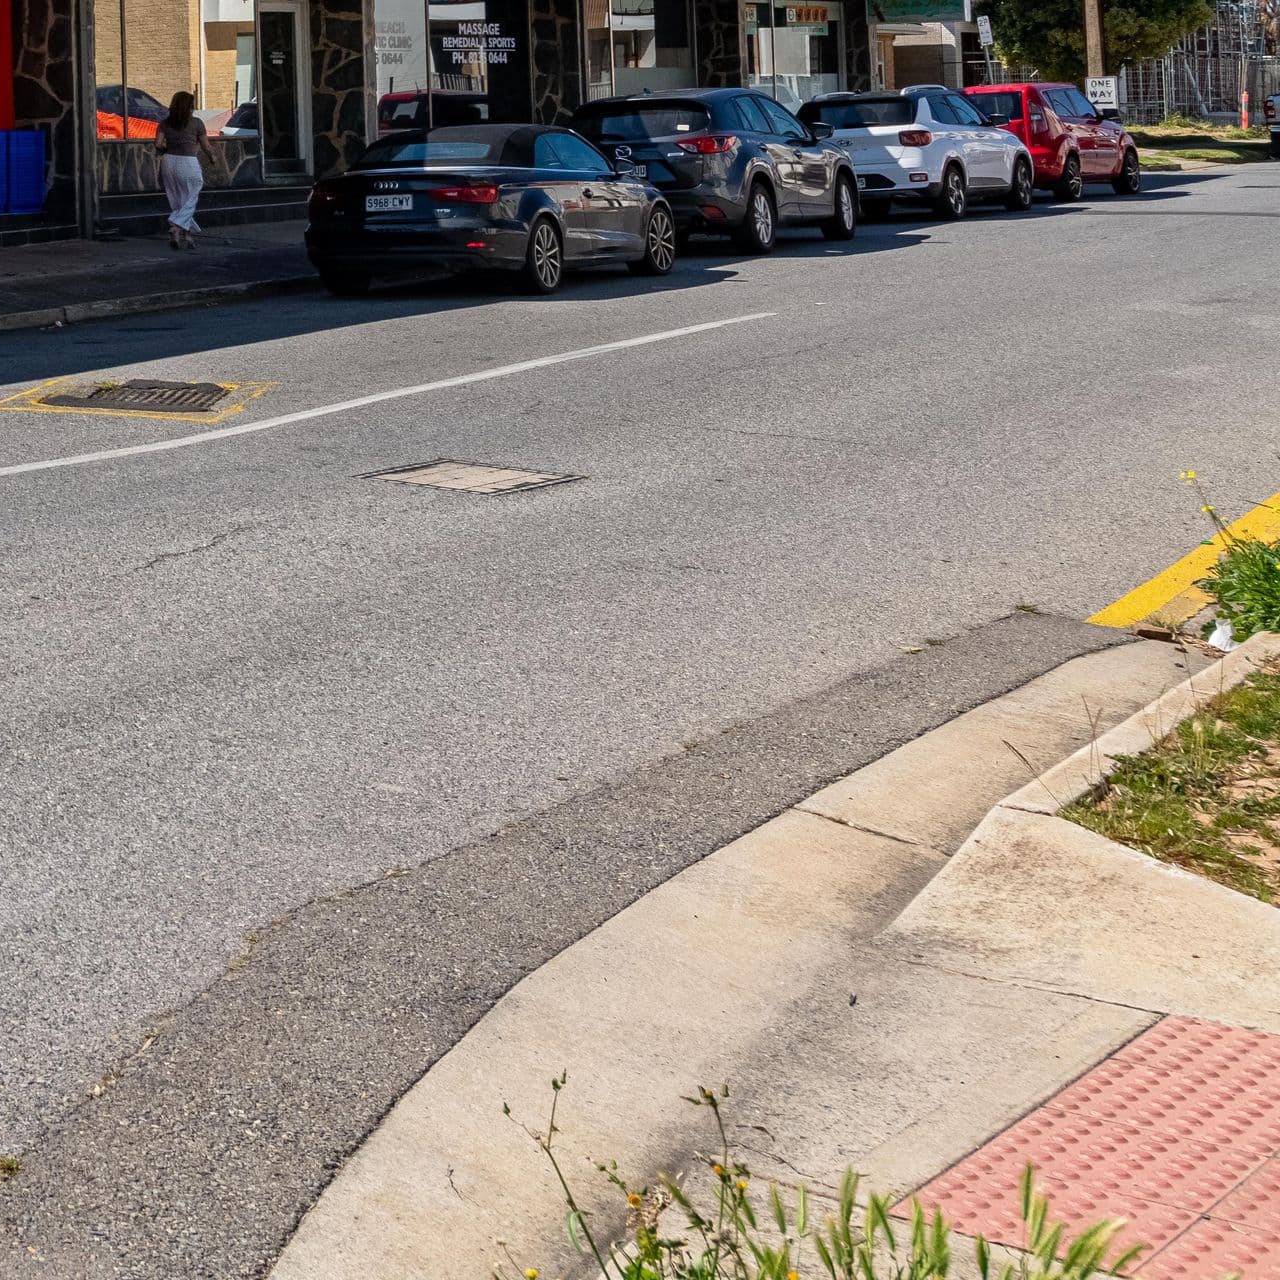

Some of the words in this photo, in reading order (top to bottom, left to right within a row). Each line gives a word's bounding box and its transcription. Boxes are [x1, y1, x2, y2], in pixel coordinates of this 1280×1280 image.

[458, 23, 500, 35] MASSAGE
[442, 37, 480, 48] REMEDIAL
[488, 37, 516, 48] SPORTS
[452, 52, 466, 64] PH.
[488, 52, 508, 64] 0644
[1090, 80, 1112, 88] ONE
[1090, 90, 1112, 98] WAY
